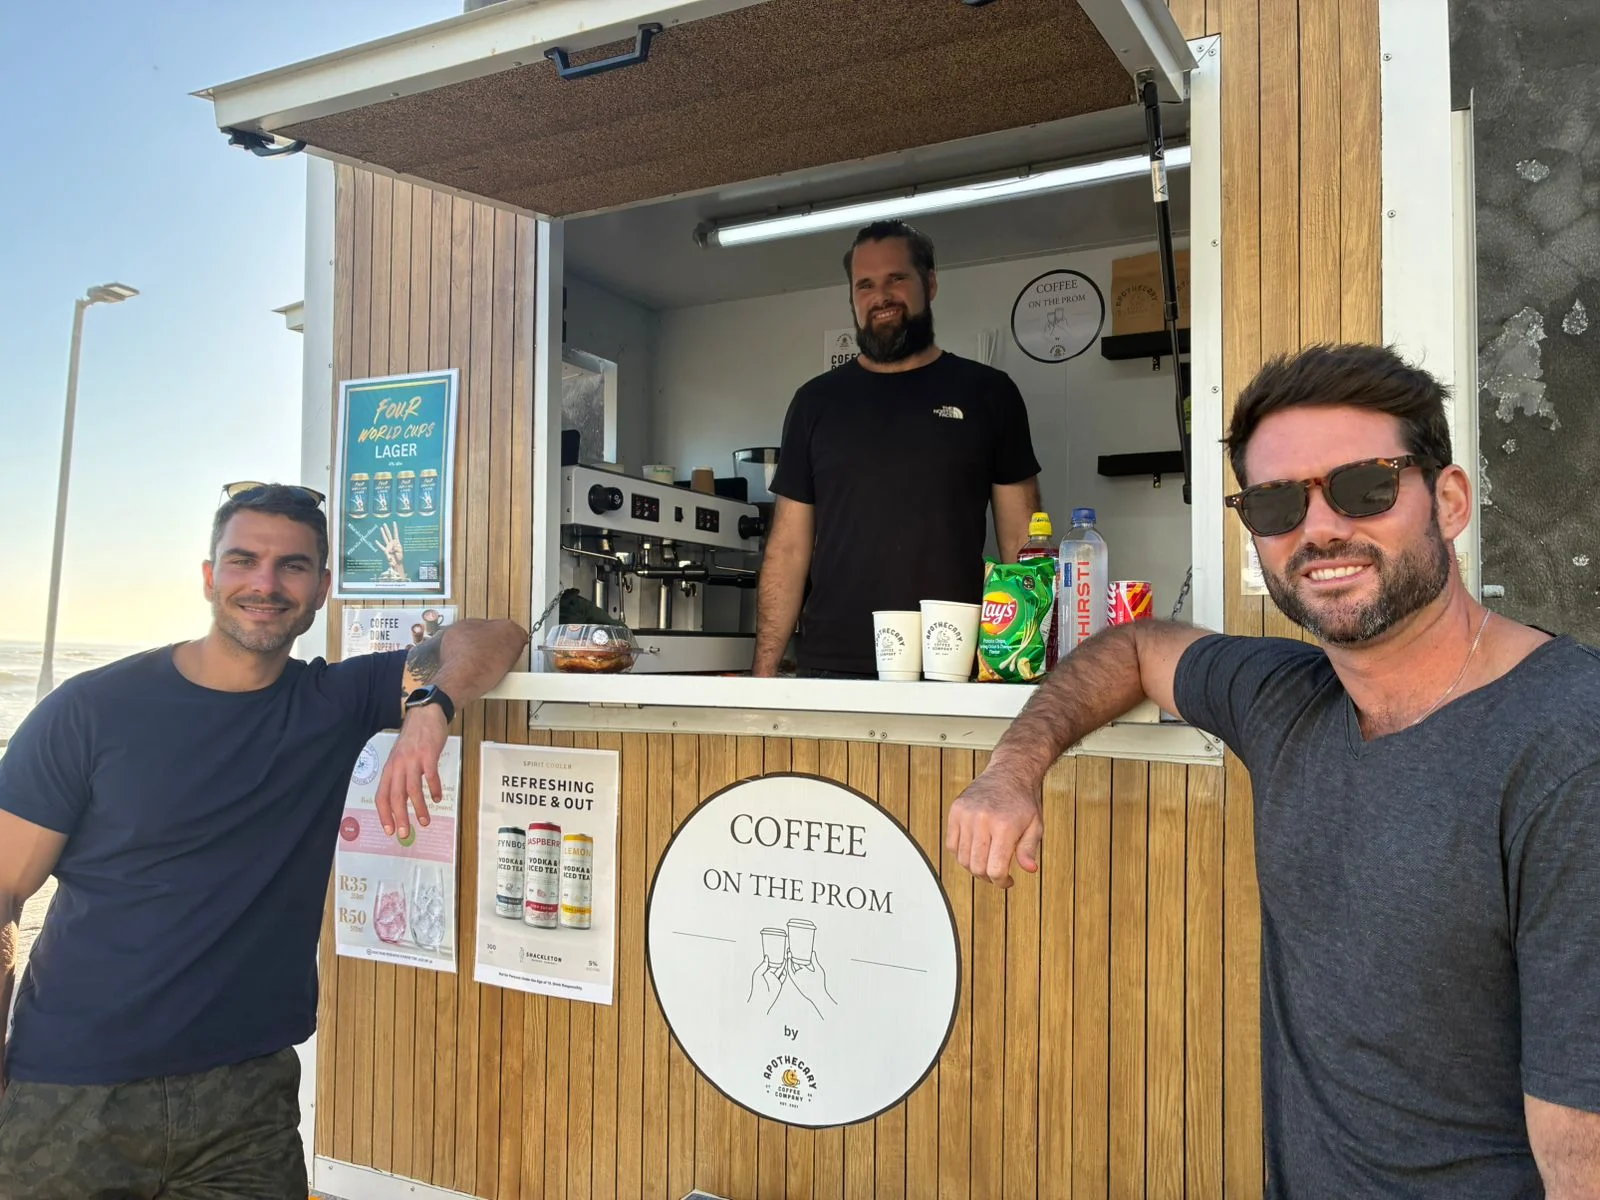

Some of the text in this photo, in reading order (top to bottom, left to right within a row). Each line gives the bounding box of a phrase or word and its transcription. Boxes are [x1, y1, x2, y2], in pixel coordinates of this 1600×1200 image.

[1036, 279, 1078, 294] COFFEE
[1028, 294, 1086, 309] ON THE PROM
[373, 396, 422, 424] FOUR
[357, 421, 436, 443] WORLD CUPS
[375, 443, 418, 459] LAGER
[980, 600, 1015, 625] Lay's
[369, 618, 400, 629] COFFEE
[370, 630, 391, 641] DONE
[926, 621, 963, 642] APOTHECARY
[523, 760, 544, 768] SPIRIT
[501, 775, 594, 794] REFRESHING
[501, 791, 594, 811] INSIDE & OUT
[730, 813, 867, 858] COFFEE
[498, 857, 518, 866] VODKA
[498, 863, 512, 871] ICED
[529, 857, 553, 867] VODKA
[529, 864, 558, 875] ICED TEA
[563, 865, 587, 874] VODKA
[563, 872, 578, 880] ICED
[339, 875, 368, 894] R35
[703, 868, 894, 915] ON THE PROM
[338, 907, 367, 925] R50
[526, 951, 562, 963] SHACKLETON
[588, 960, 599, 968] 5%
[784, 1024, 799, 1041] by
[763, 1055, 817, 1090] APOTHECARY
[774, 1091, 804, 1102] COMPANY
[777, 1086, 801, 1096] COFFEE
